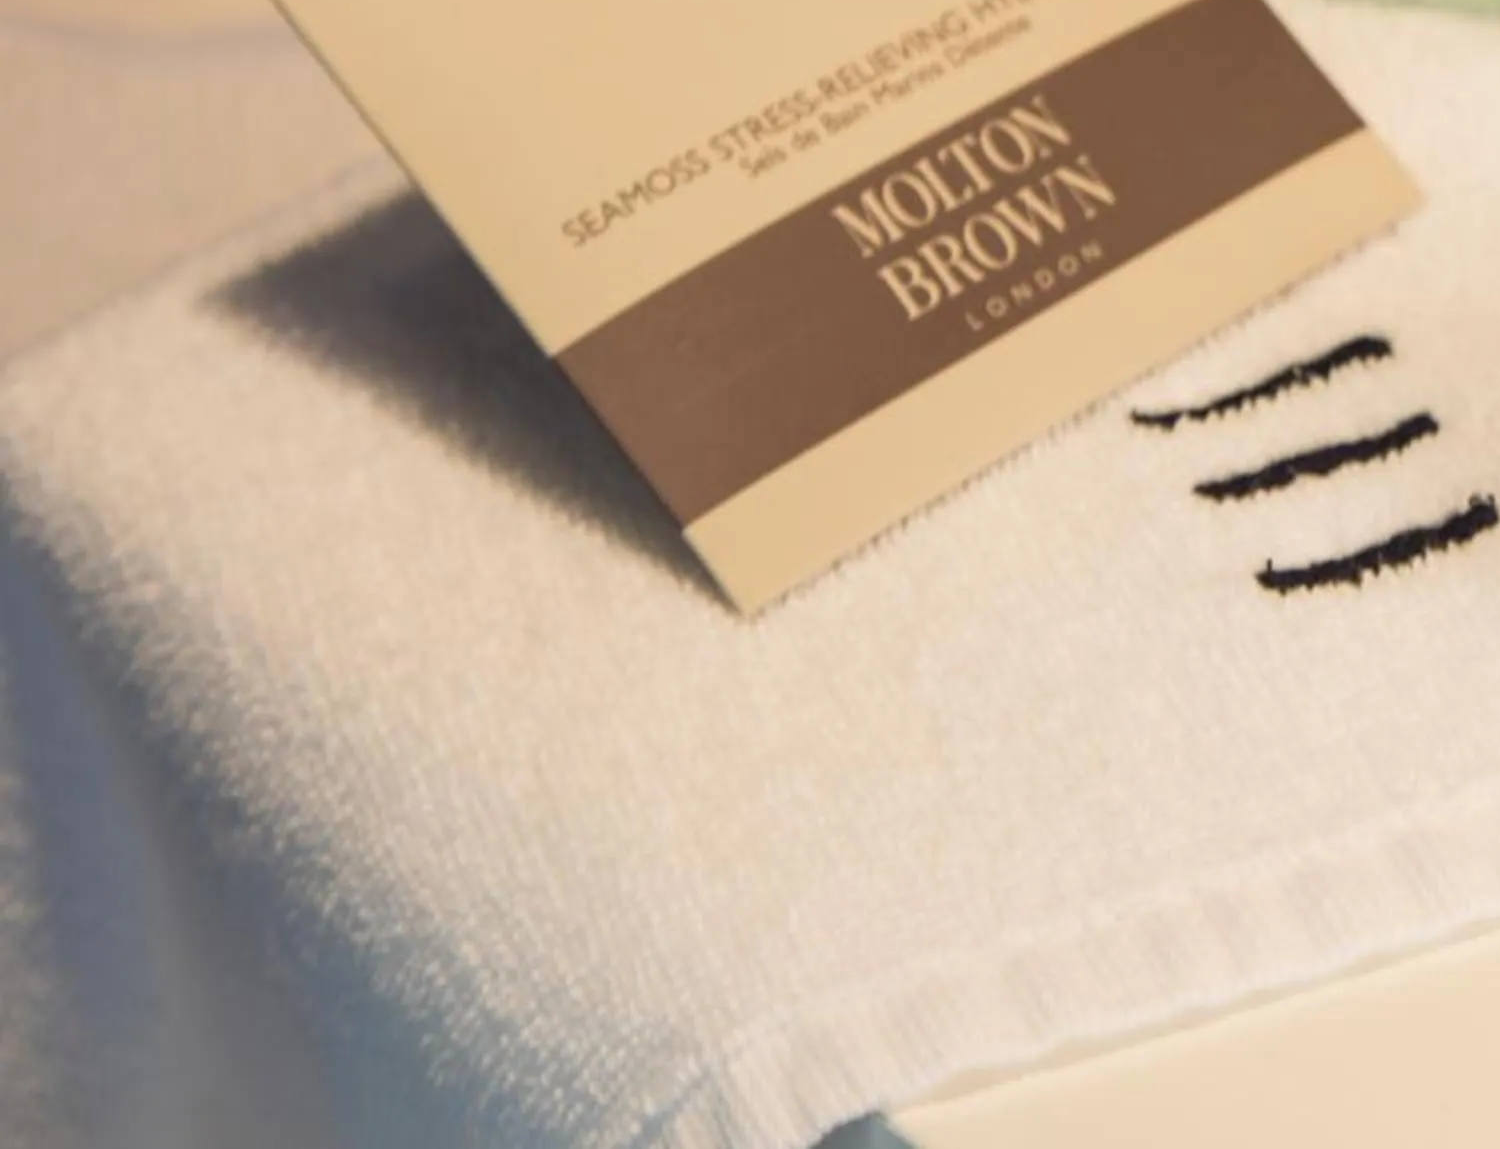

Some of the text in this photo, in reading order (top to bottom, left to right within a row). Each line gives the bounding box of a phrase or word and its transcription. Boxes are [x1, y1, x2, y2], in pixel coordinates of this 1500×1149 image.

[560, 146, 710, 249] SEAMOSS
[707, 5, 972, 163] STRESS-RELIEVING
[829, 94, 1072, 260] MOLTON
[876, 153, 1118, 322] BROWN
[963, 238, 1105, 332] LONDON
